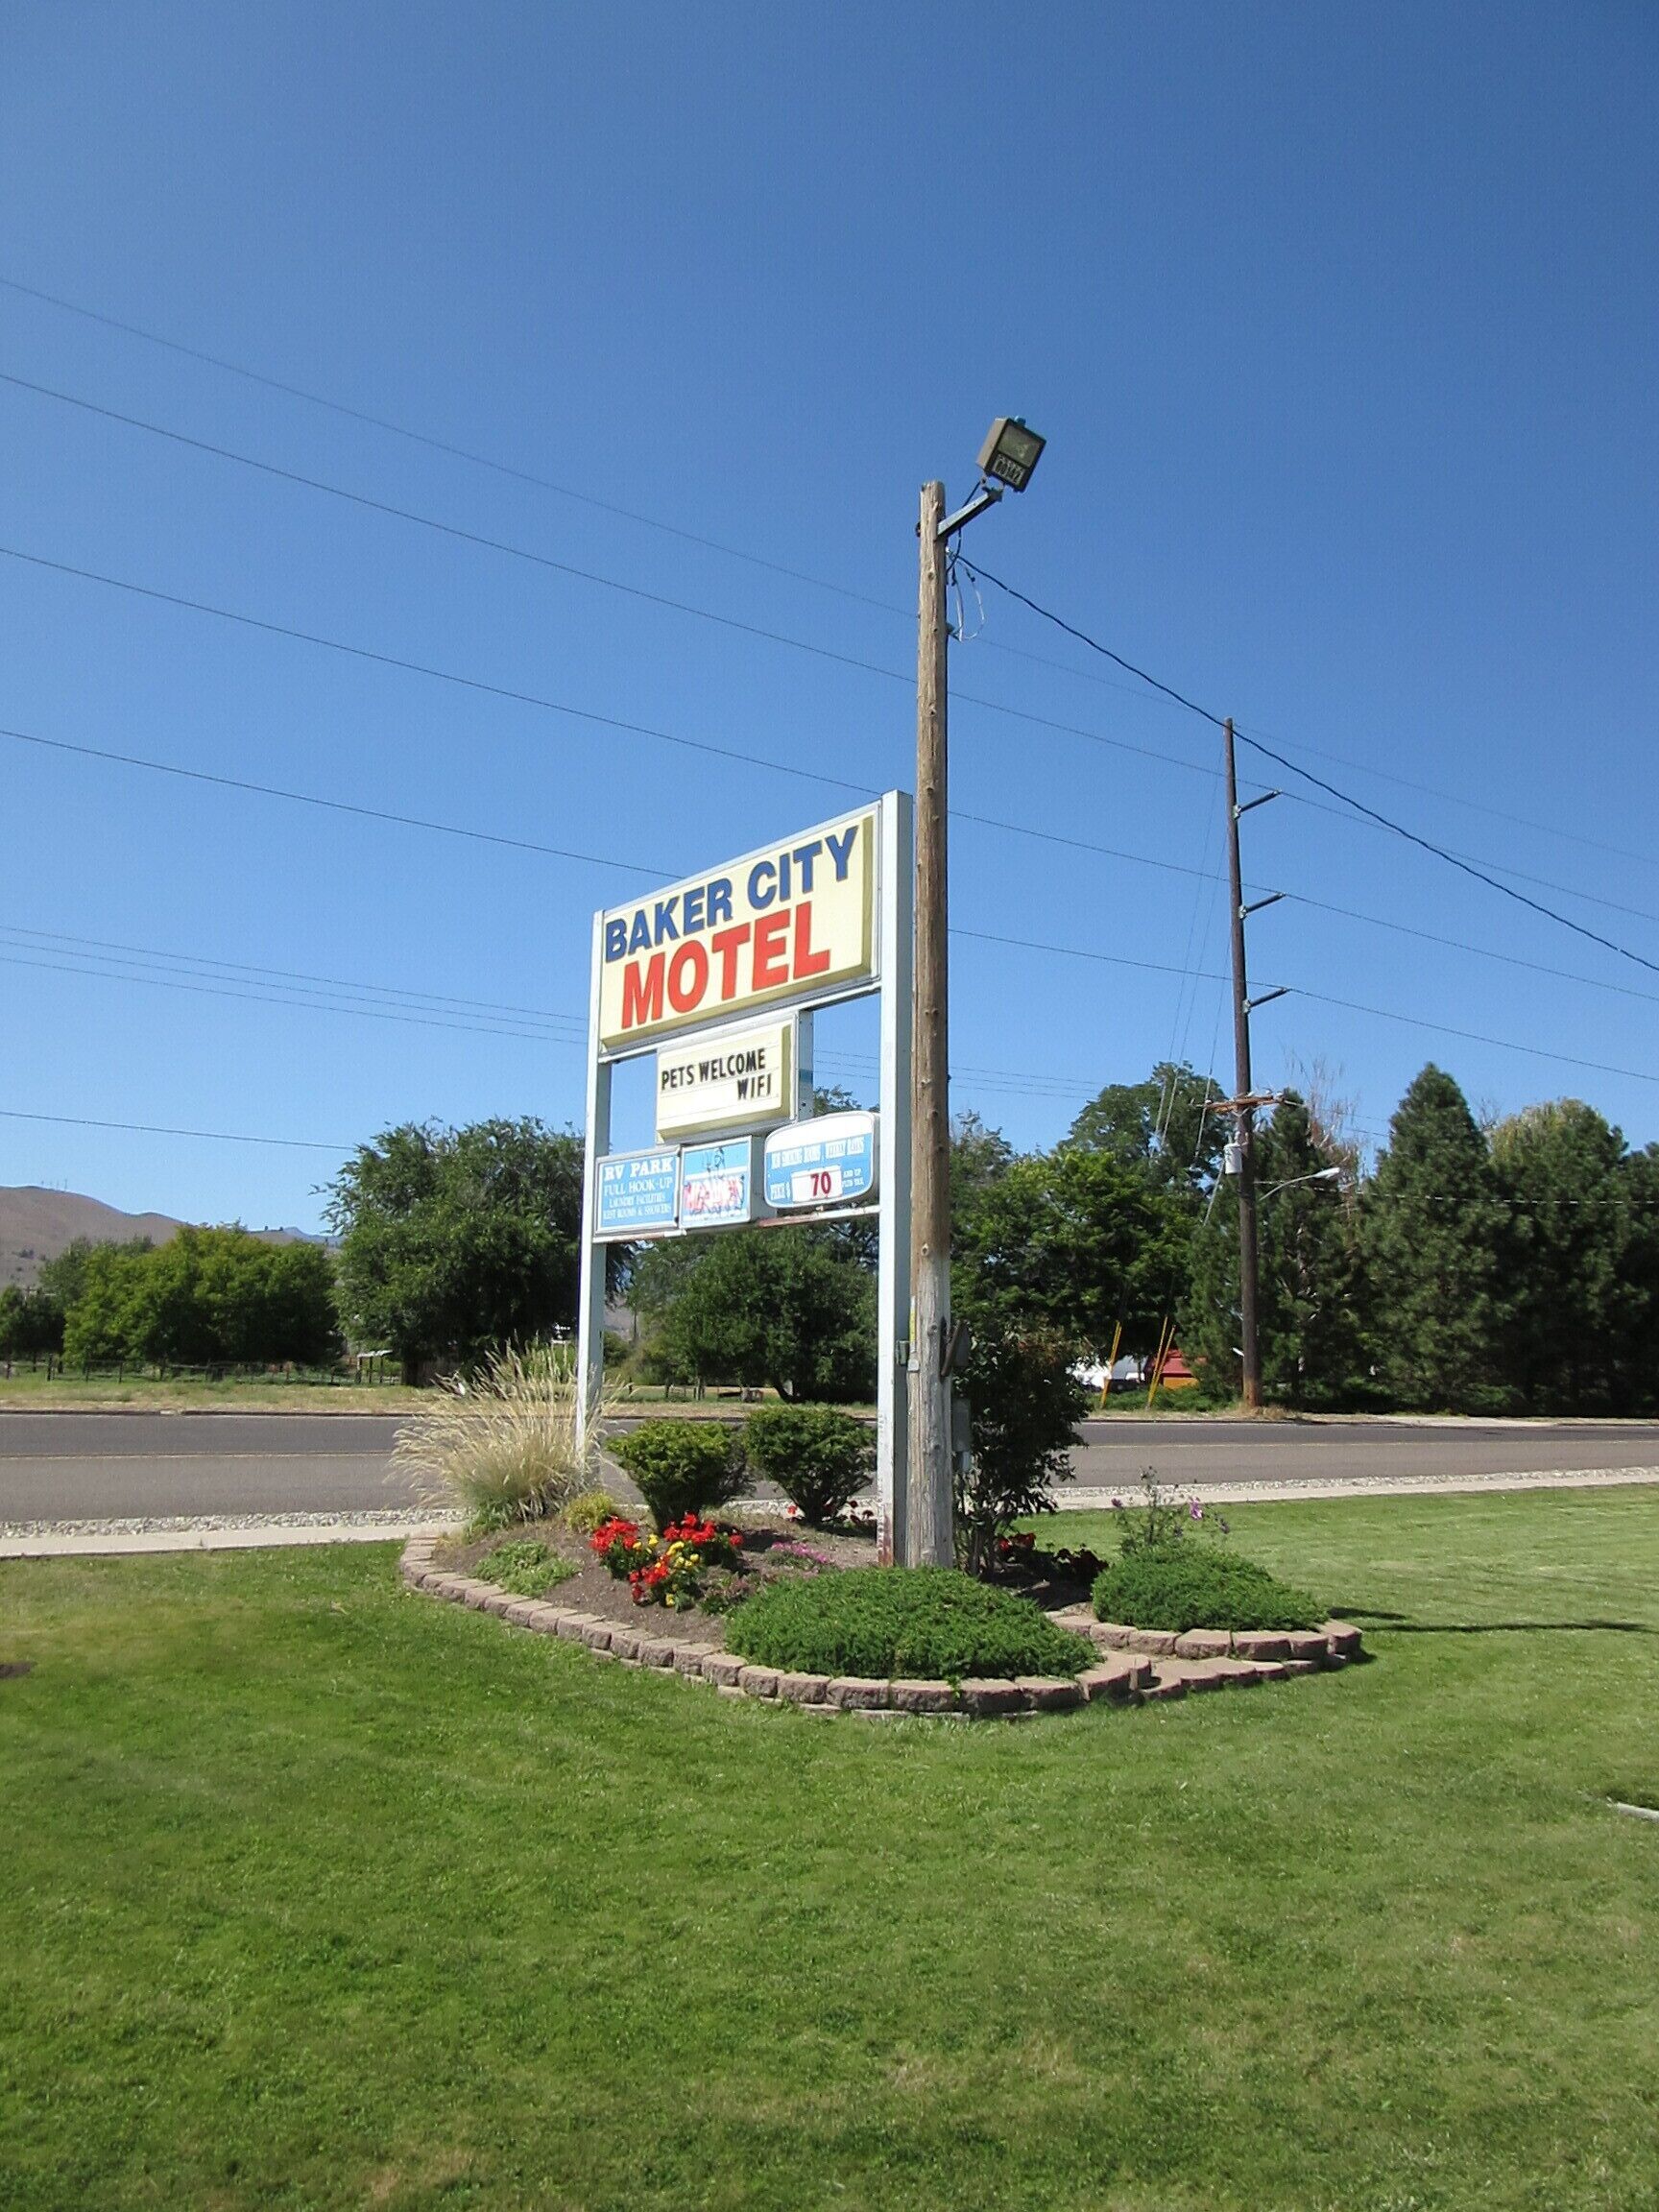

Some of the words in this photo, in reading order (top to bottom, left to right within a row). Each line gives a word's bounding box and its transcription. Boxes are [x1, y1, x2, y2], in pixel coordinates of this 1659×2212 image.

[605, 877, 733, 964] BAKER
[747, 825, 859, 911] CITY
[621, 901, 831, 1030] MOTEL
[661, 1064, 694, 1091] PETS
[698, 1047, 766, 1082] WELCOME
[736, 1072, 772, 1100] WIFI
[604, 1164, 625, 1182] RV
[629, 1157, 674, 1178] PARK
[810, 1170, 832, 1197] 70
[603, 1182, 626, 1197] FULL
[628, 1176, 674, 1193] HOOK-UP
